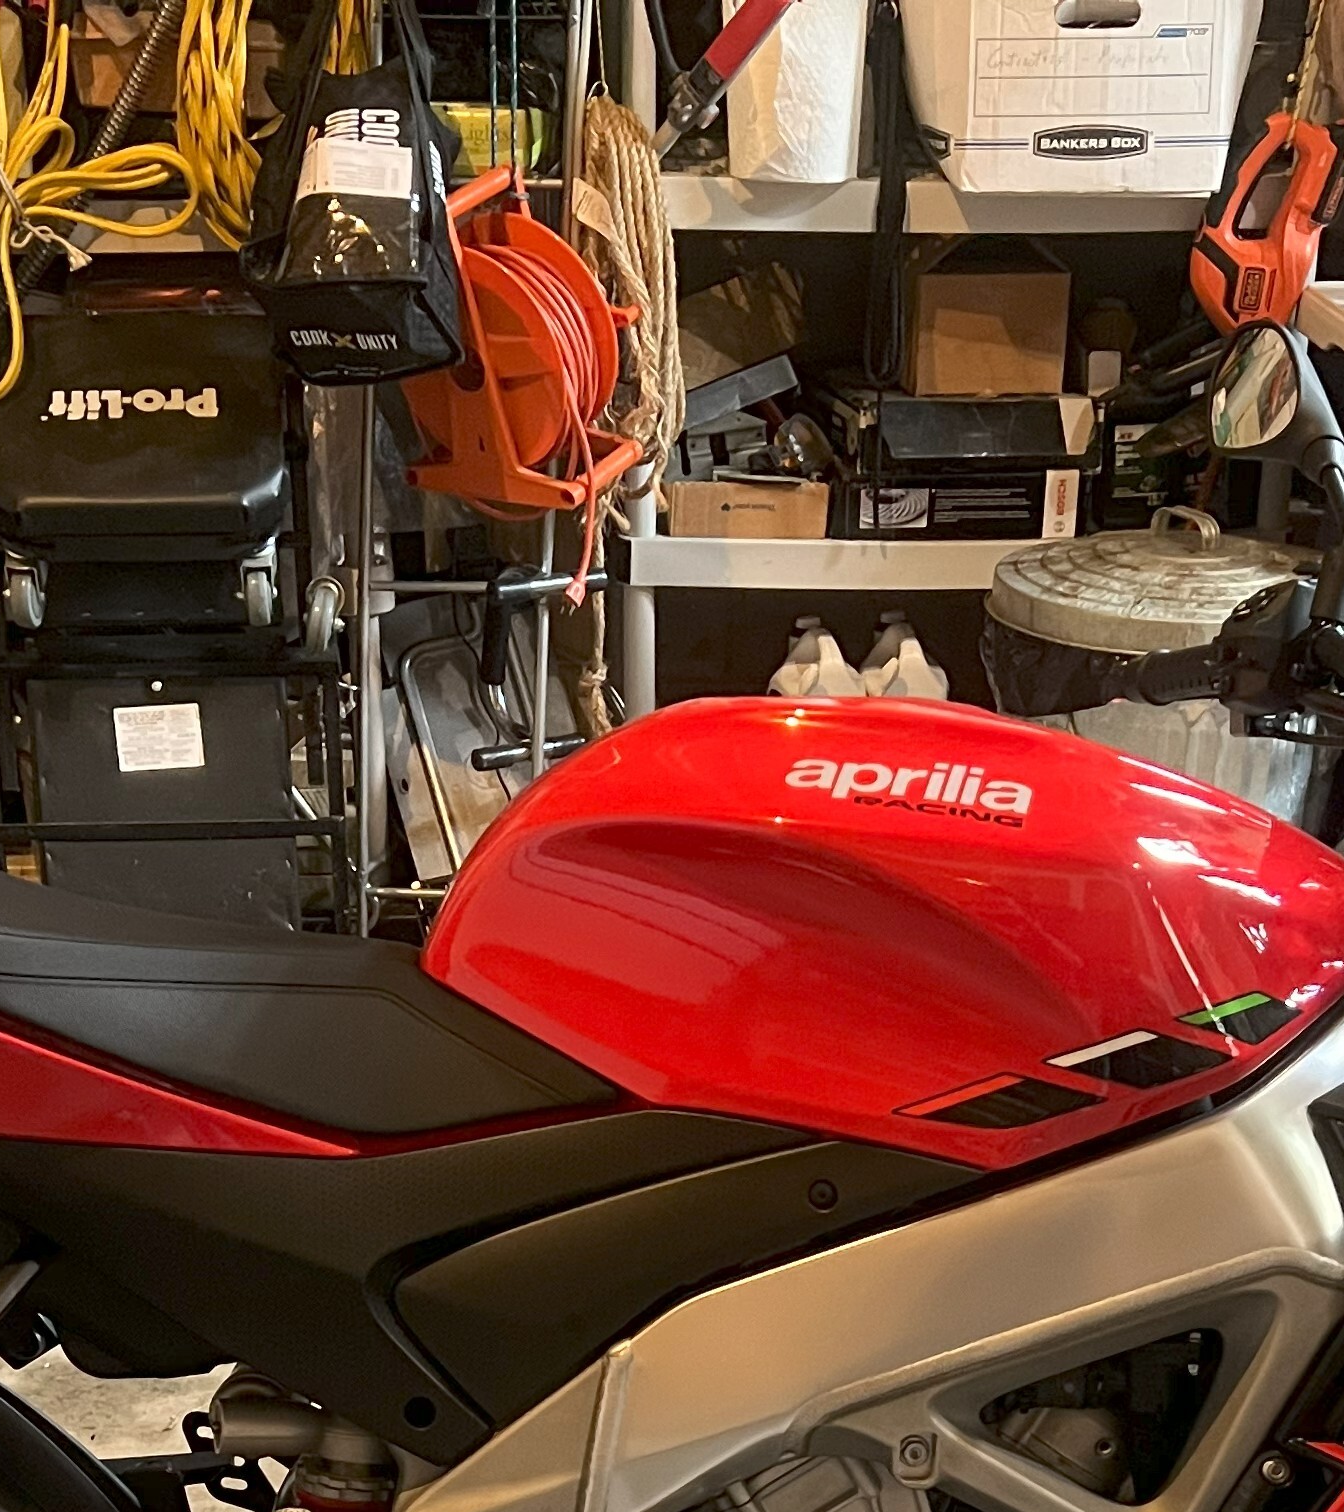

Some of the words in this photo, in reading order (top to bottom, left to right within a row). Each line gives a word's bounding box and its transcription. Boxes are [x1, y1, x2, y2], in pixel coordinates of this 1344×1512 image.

[1039, 137, 1108, 150] BANKERS
[1110, 136, 1142, 150] BOX
[289, 328, 334, 347] COOK
[355, 332, 399, 351] UNITY
[48, 387, 220, 421] Pro-Lift
[1056, 478, 1067, 516] BOSCH
[784, 758, 1034, 815] aprilia
[853, 795, 1025, 829] RACING
